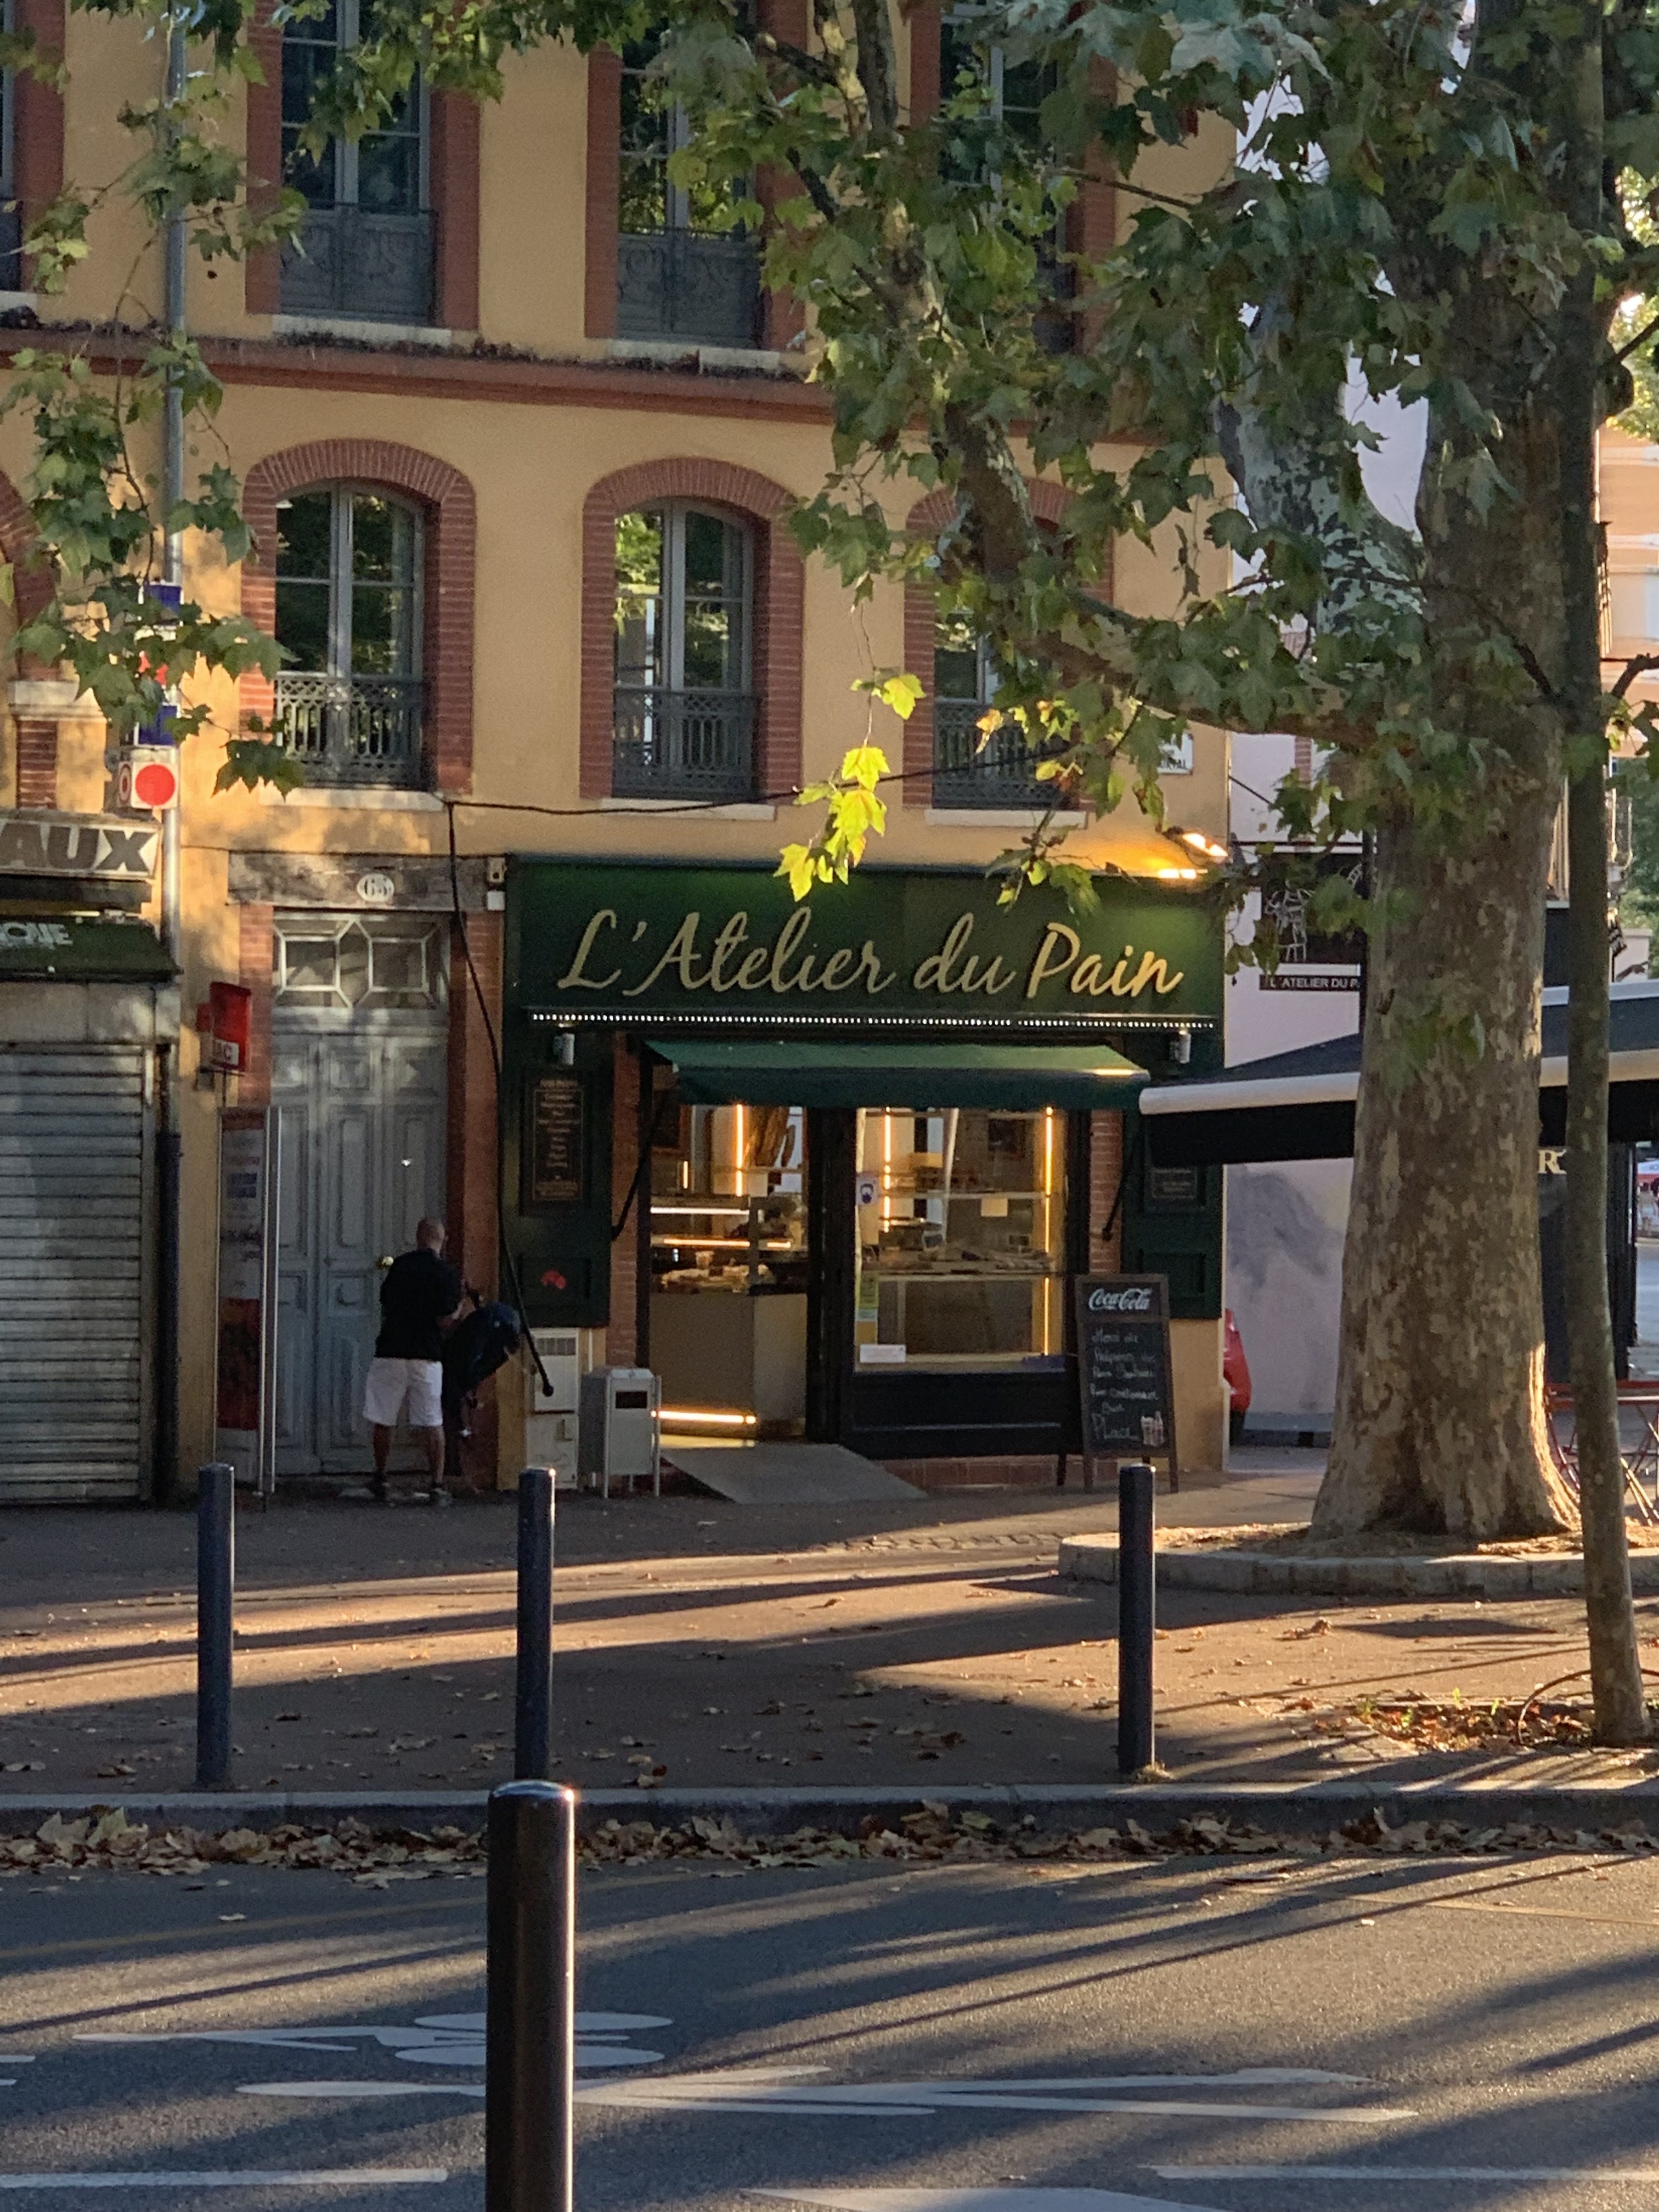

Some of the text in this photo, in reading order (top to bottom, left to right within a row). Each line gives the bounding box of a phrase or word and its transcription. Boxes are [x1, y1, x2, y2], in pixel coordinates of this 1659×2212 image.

[0, 825, 155, 872] AUX
[557, 906, 1184, 998] L'Atelier du Pain
[1331, 978, 1348, 988] DU
